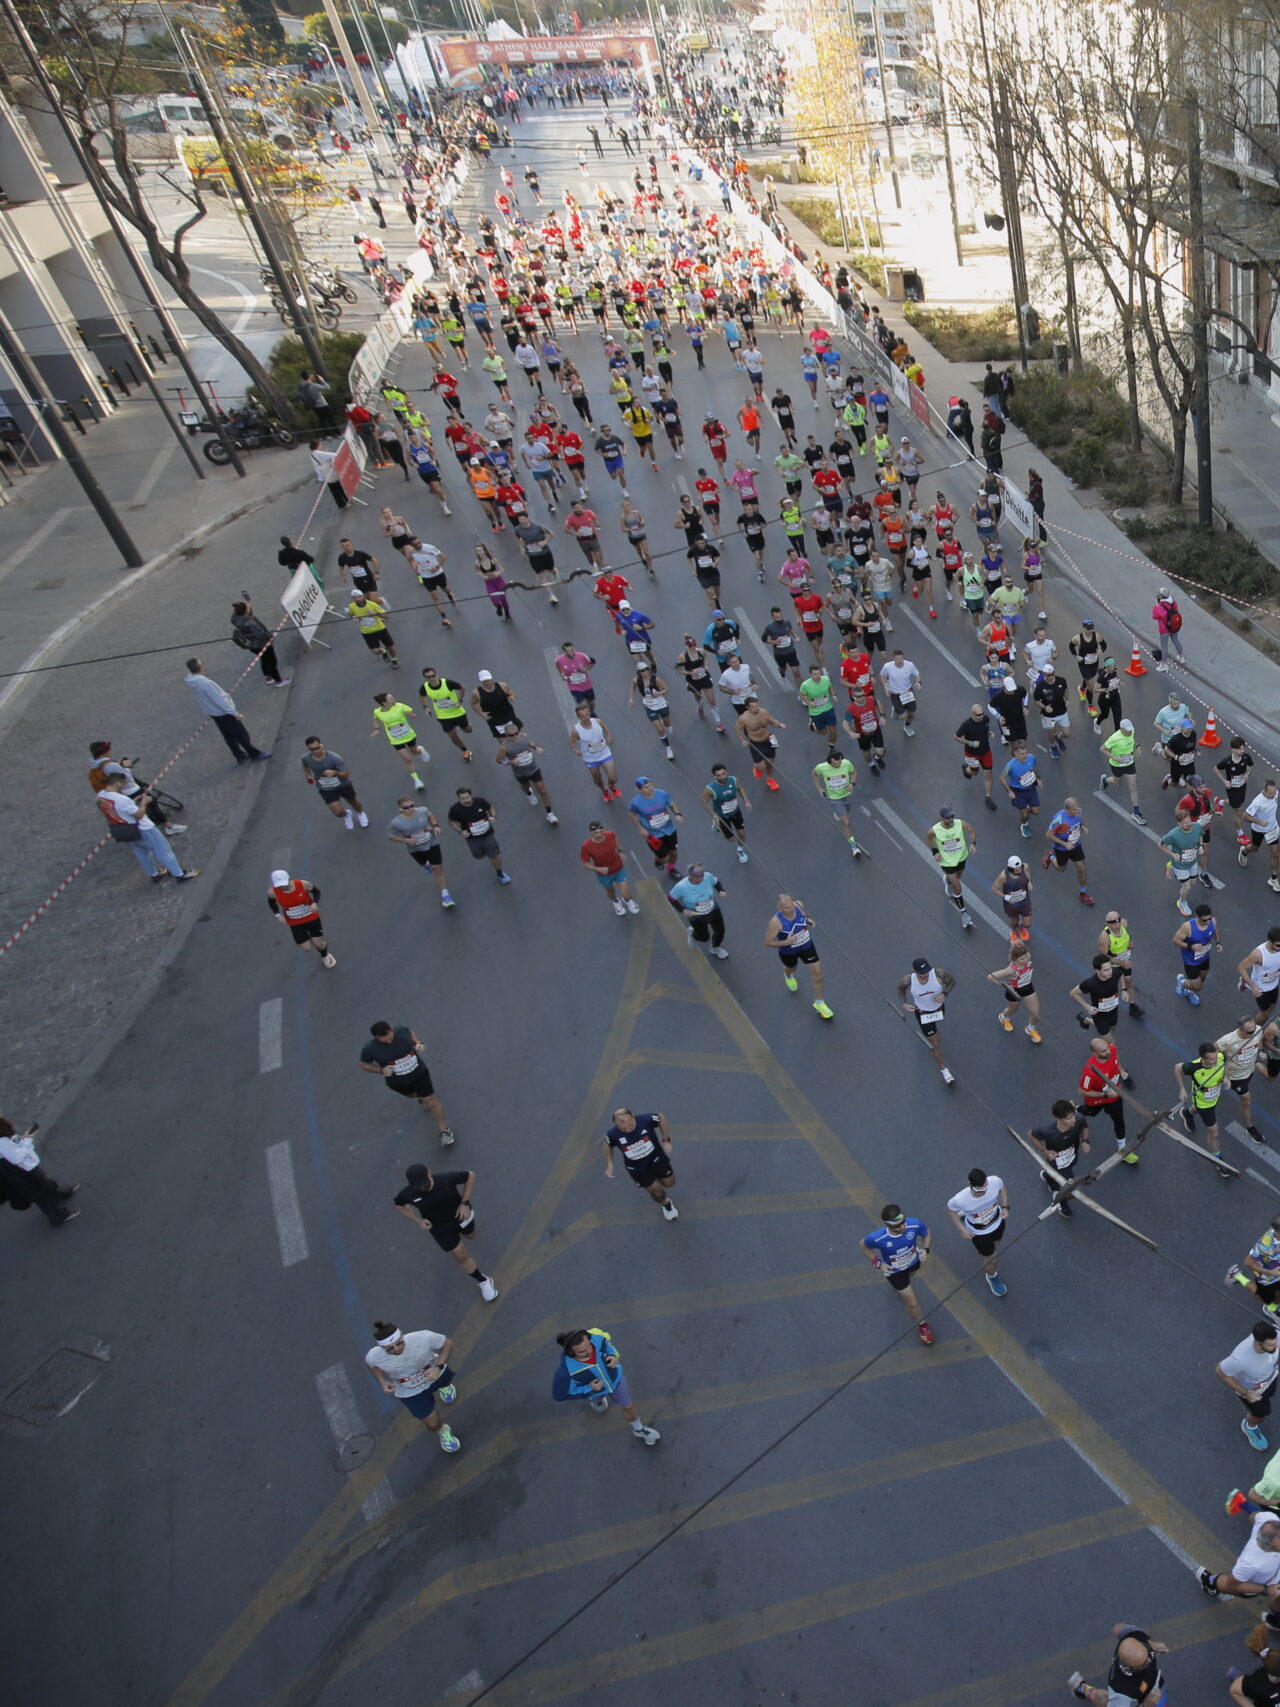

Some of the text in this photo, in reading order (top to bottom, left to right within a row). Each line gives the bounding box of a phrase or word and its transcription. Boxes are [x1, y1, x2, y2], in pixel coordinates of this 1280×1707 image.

[494, 40, 605, 52] ATHENS HALF MARATHON
[292, 583, 319, 627] Deloitte
